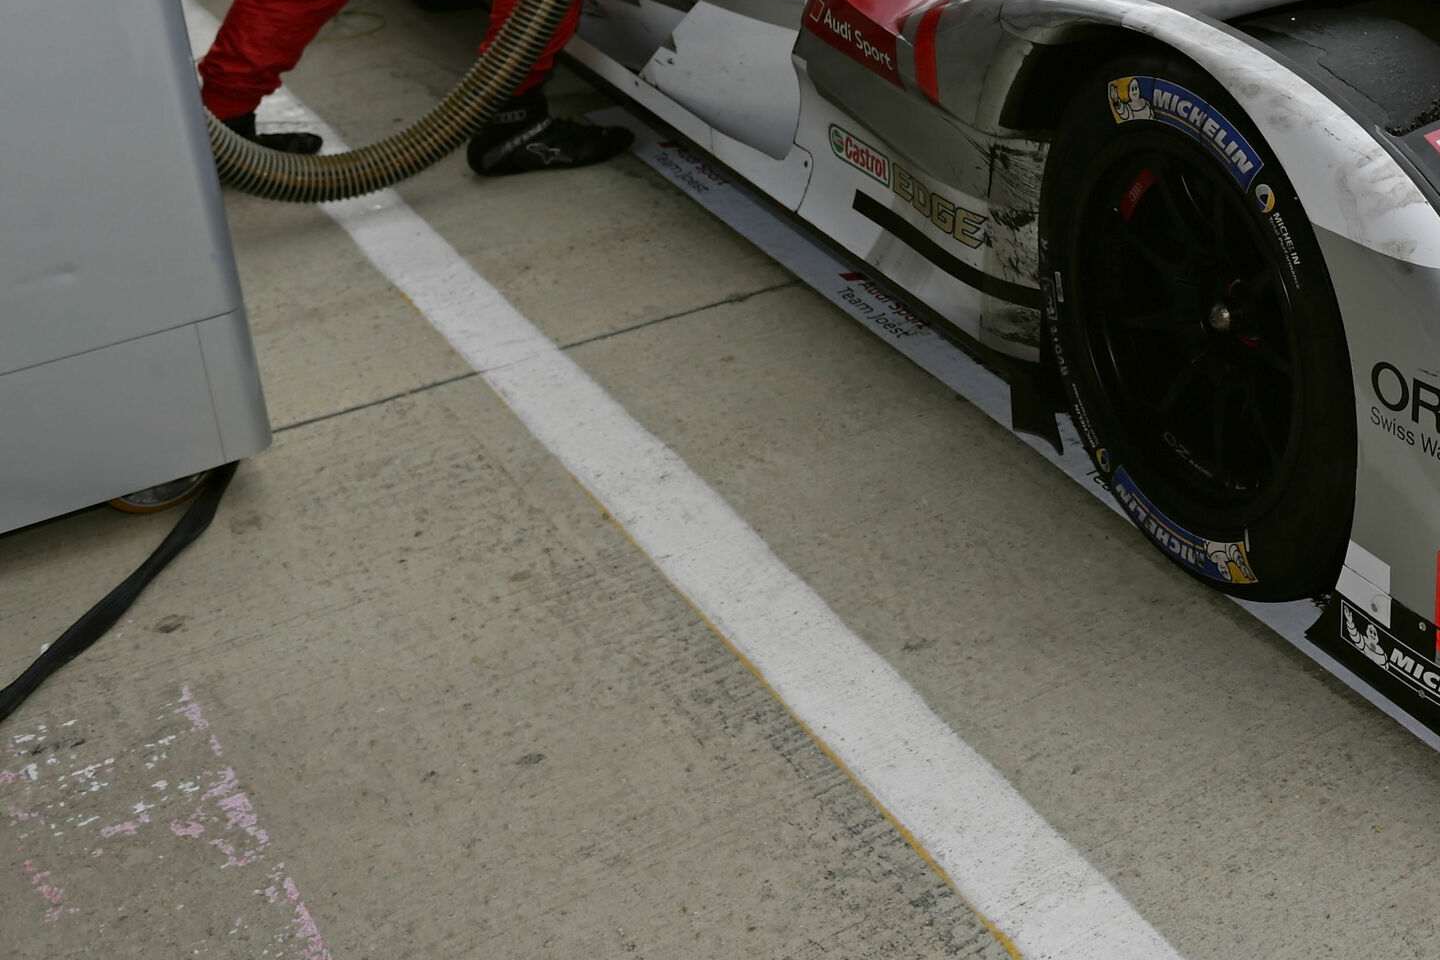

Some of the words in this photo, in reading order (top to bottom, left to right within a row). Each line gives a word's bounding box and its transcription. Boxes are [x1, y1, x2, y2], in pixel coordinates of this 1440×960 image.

[824, 7, 852, 42] Audi
[854, 29, 893, 71] Sport
[845, 136, 888, 182] Castrol
[1153, 88, 1254, 175] MICHELIN
[892, 162, 989, 249] EDGE
[1272, 211, 1300, 266] MICHELIN
[837, 286, 874, 314] Team
[867, 312, 910, 339] Joest
[859, 281, 891, 304] Audi
[888, 302, 931, 330] Sport
[1370, 406, 1415, 446] Swiss
[1116, 483, 1206, 569] MICHELIN
